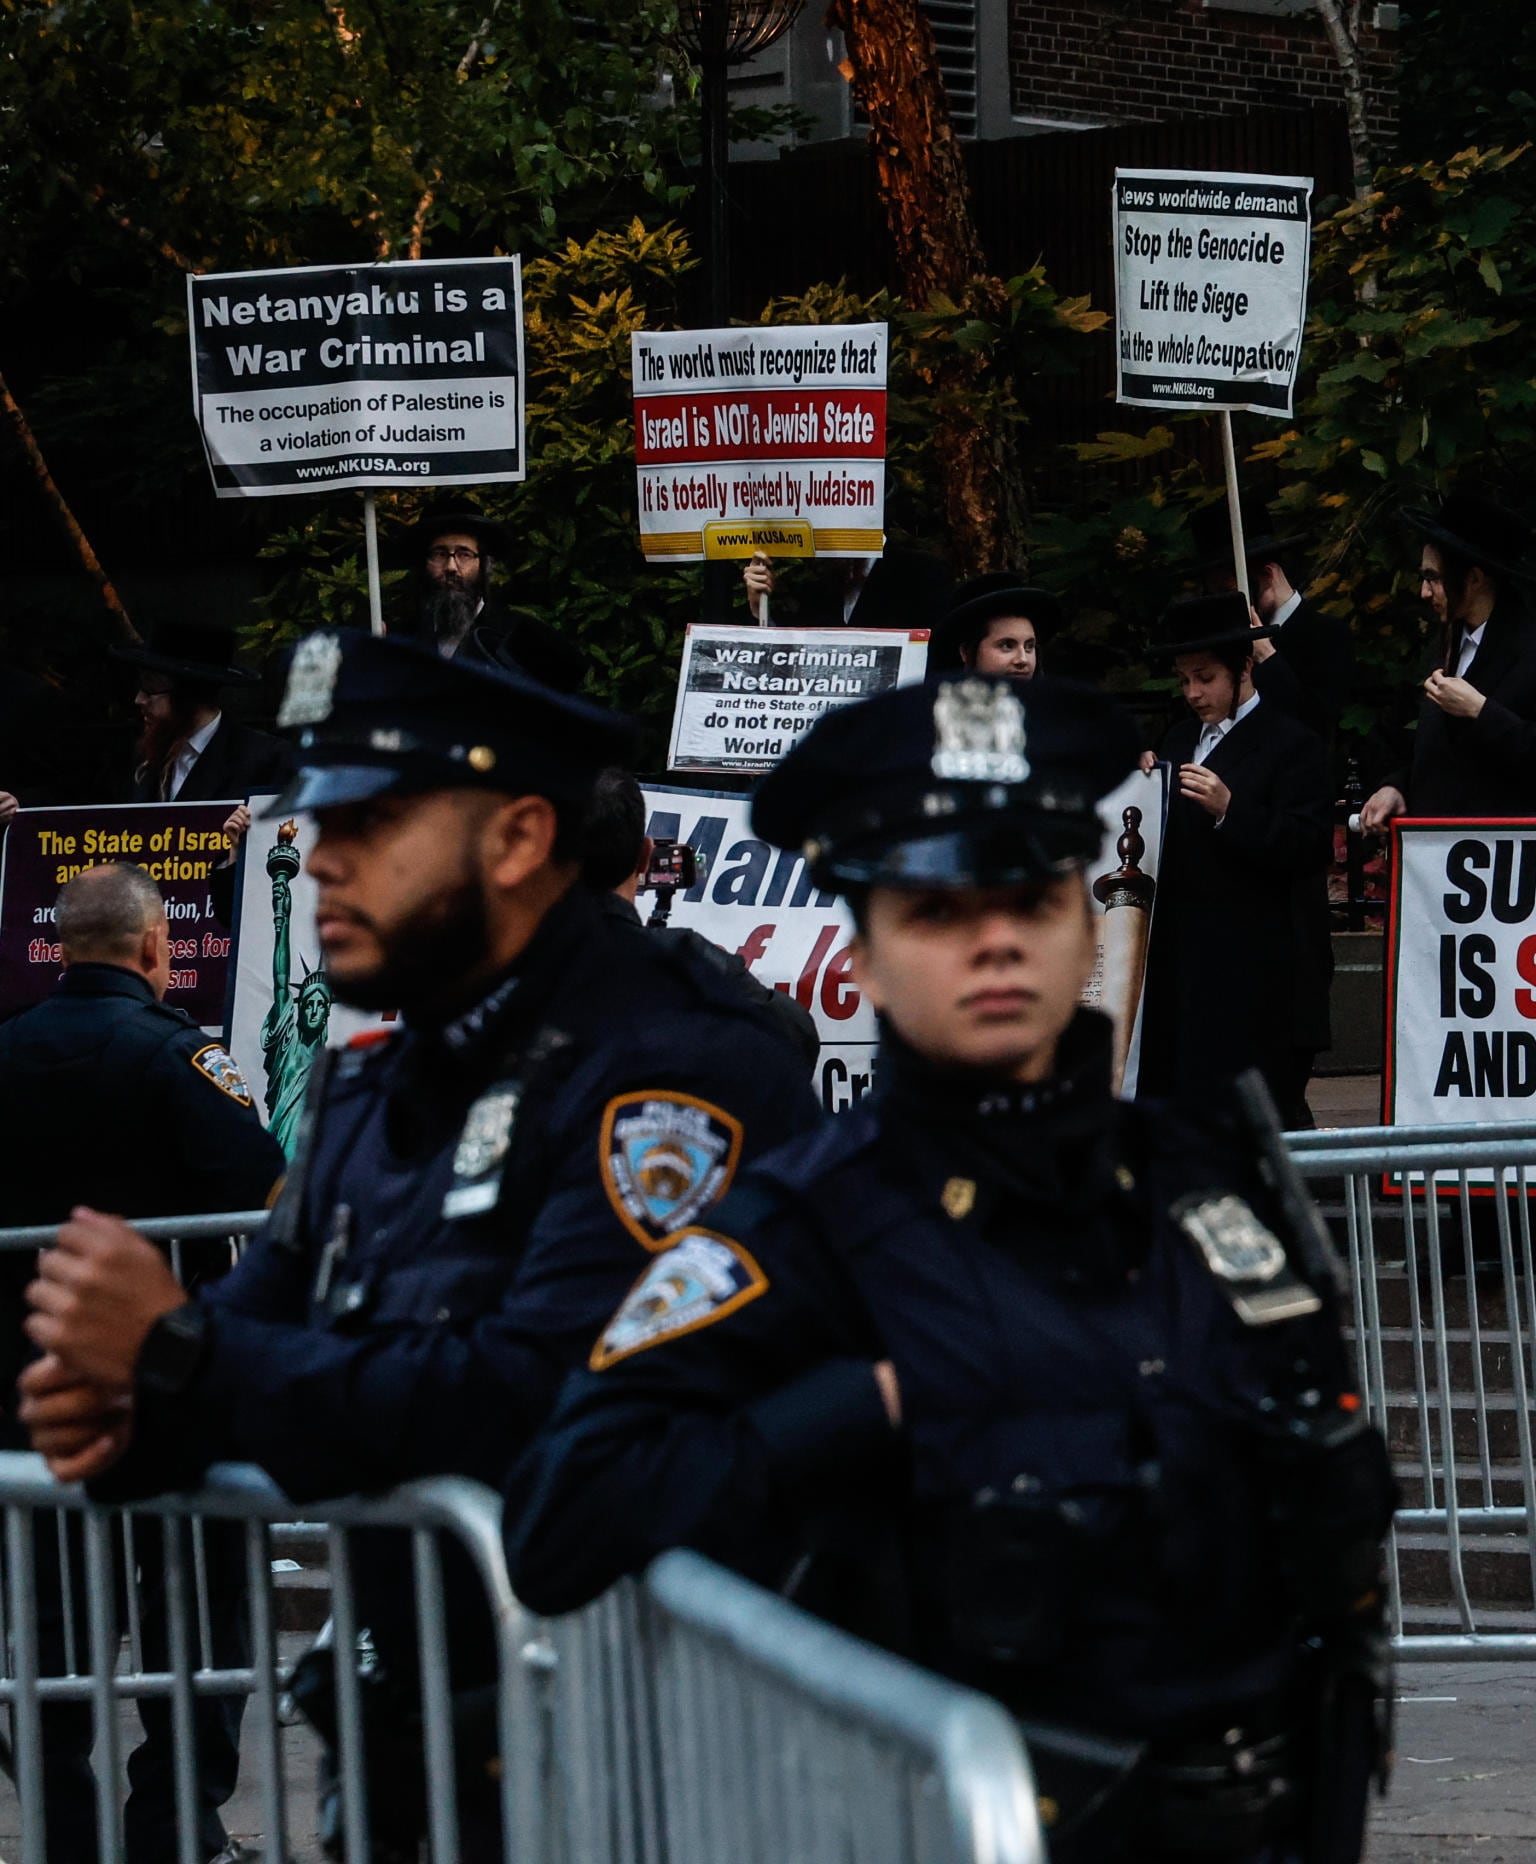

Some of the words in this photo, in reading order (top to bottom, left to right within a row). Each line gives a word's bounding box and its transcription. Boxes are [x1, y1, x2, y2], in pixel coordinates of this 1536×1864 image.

[1158, 188, 1231, 209] worldwide
[1234, 191, 1298, 215] demand
[1125, 225, 1161, 264] Stop
[1167, 227, 1193, 259] the
[1198, 228, 1285, 264] Genocide
[201, 284, 420, 328] Netanyahu
[433, 282, 468, 313] is
[482, 287, 507, 311] a
[1140, 279, 1170, 312] Lift
[1174, 282, 1199, 313] the
[1201, 282, 1249, 323] Siege
[225, 343, 307, 376] War
[319, 331, 486, 369] Criminal
[640, 347, 664, 381] The
[669, 344, 715, 379] world
[718, 342, 756, 377] must
[760, 340, 836, 384] recognize
[841, 340, 877, 374] that
[1133, 331, 1153, 362] the
[1158, 333, 1194, 365] whole
[1196, 335, 1295, 375] Occupation
[1152, 382, 1215, 399] www.NKUSA.org
[216, 405, 254, 424] The
[259, 396, 362, 425] occupation
[367, 394, 389, 412] of
[392, 391, 484, 412] Palestine
[489, 390, 506, 409] is
[260, 436, 273, 452] a
[277, 430, 351, 451] violation
[355, 425, 377, 443] of
[380, 424, 465, 443] Judaism
[643, 406, 689, 451] Israel
[693, 408, 710, 447] is
[715, 404, 751, 445] NOT
[752, 419, 761, 444] a
[763, 402, 818, 445] Jewish
[824, 401, 875, 444] State
[296, 458, 430, 478] www.NKUSA.org
[643, 477, 654, 512] It
[656, 477, 669, 511] is
[672, 472, 728, 518] totally
[733, 473, 783, 516] rejected
[787, 473, 802, 516] by
[805, 470, 875, 508] Judaism
[715, 648, 769, 666] war
[772, 649, 878, 669] criminal
[722, 671, 863, 698] Netanyahu
[715, 698, 741, 709] and
[744, 699, 766, 710] the
[769, 699, 806, 711] State
[809, 700, 822, 711] of
[704, 712, 729, 728] do
[735, 714, 769, 730] not
[724, 737, 782, 755] World
[38, 830, 76, 856] The
[83, 828, 143, 855] State
[150, 826, 174, 851] of
[179, 826, 232, 851] Israe
[202, 932, 231, 958] for
[1439, 933, 1497, 1019] IS
